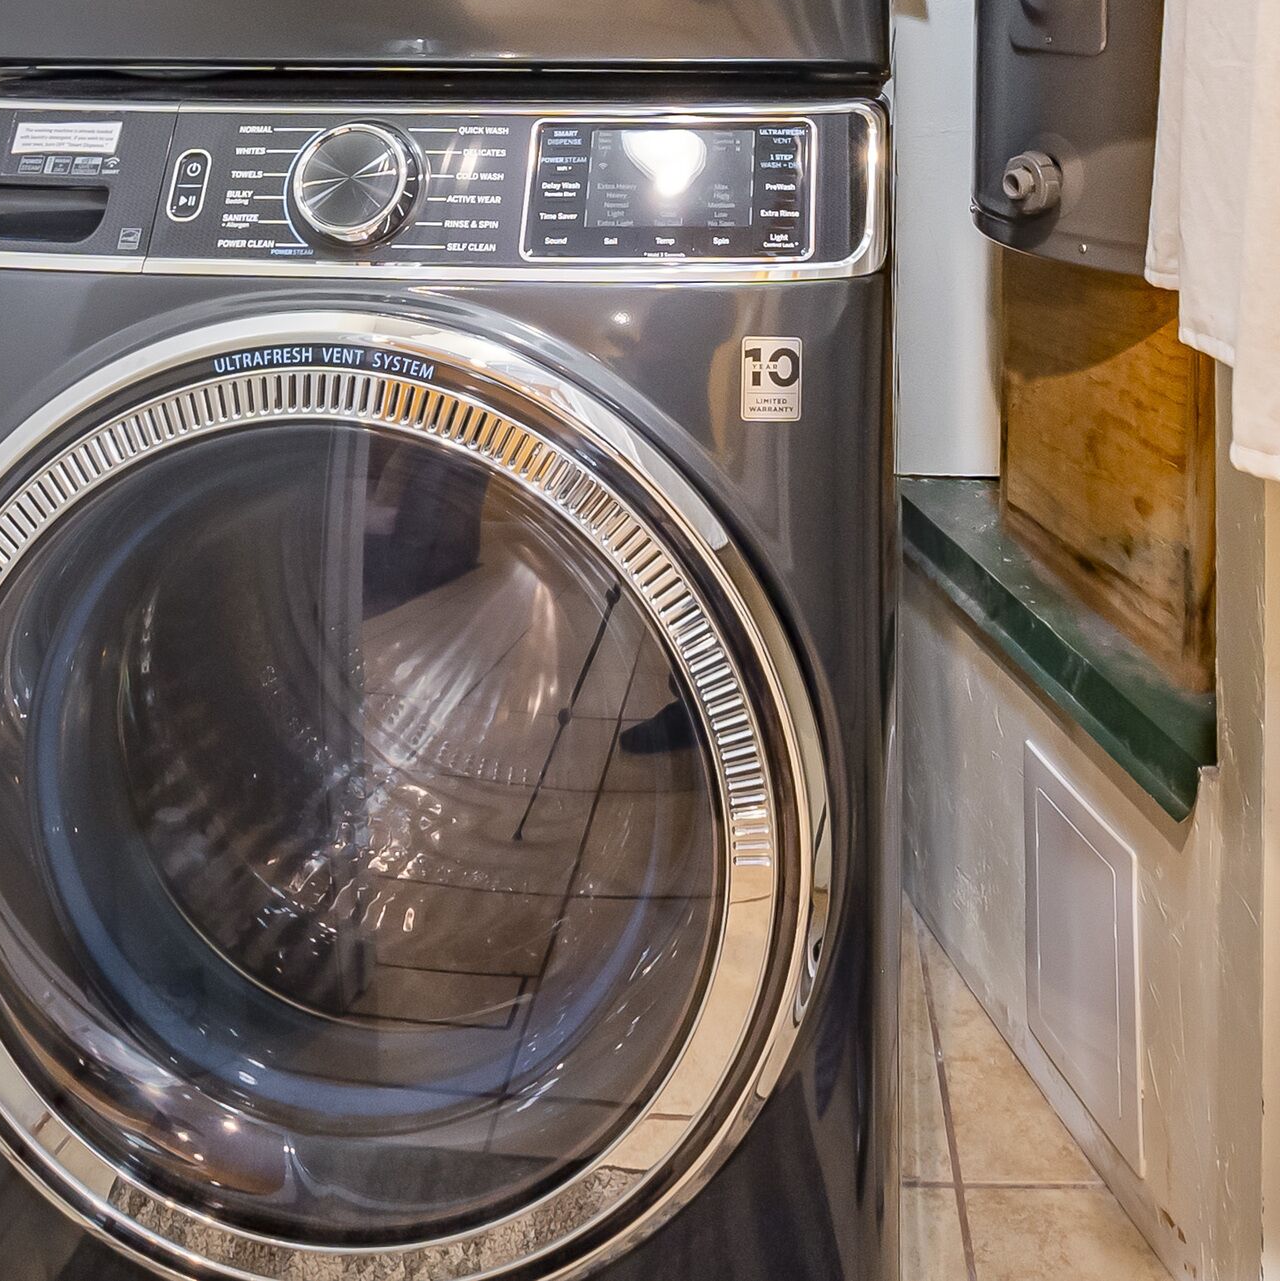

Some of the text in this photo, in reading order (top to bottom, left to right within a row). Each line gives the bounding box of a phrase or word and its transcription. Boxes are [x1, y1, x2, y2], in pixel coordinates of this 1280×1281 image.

[239, 126, 273, 134] NORMAL
[458, 126, 510, 135] QUICK WASH
[235, 147, 266, 155] WHITES
[463, 149, 507, 157] DELICATES
[231, 171, 263, 179] TOWELS
[541, 182, 561, 190] Delay
[765, 183, 796, 191] PreWash
[226, 190, 254, 198] BULKY
[446, 195, 502, 204] ACTIVE WEAR
[539, 212, 578, 220] Time Saver
[760, 209, 800, 217] Extra Rinse
[222, 214, 259, 222] SANITIZE
[444, 220, 499, 229] RINSE & SPIN
[544, 237, 568, 245] Sound
[603, 237, 618, 245] Soil
[655, 237, 675, 246] Temp
[713, 237, 730, 246] Spin
[770, 233, 789, 242] Light
[217, 240, 275, 248] POWER CLEAN
[446, 243, 497, 252] SELF CLEAN
[213, 346, 435, 380] ULTRAFRESH VENT SYSTEM
[745, 348, 800, 387] 10
